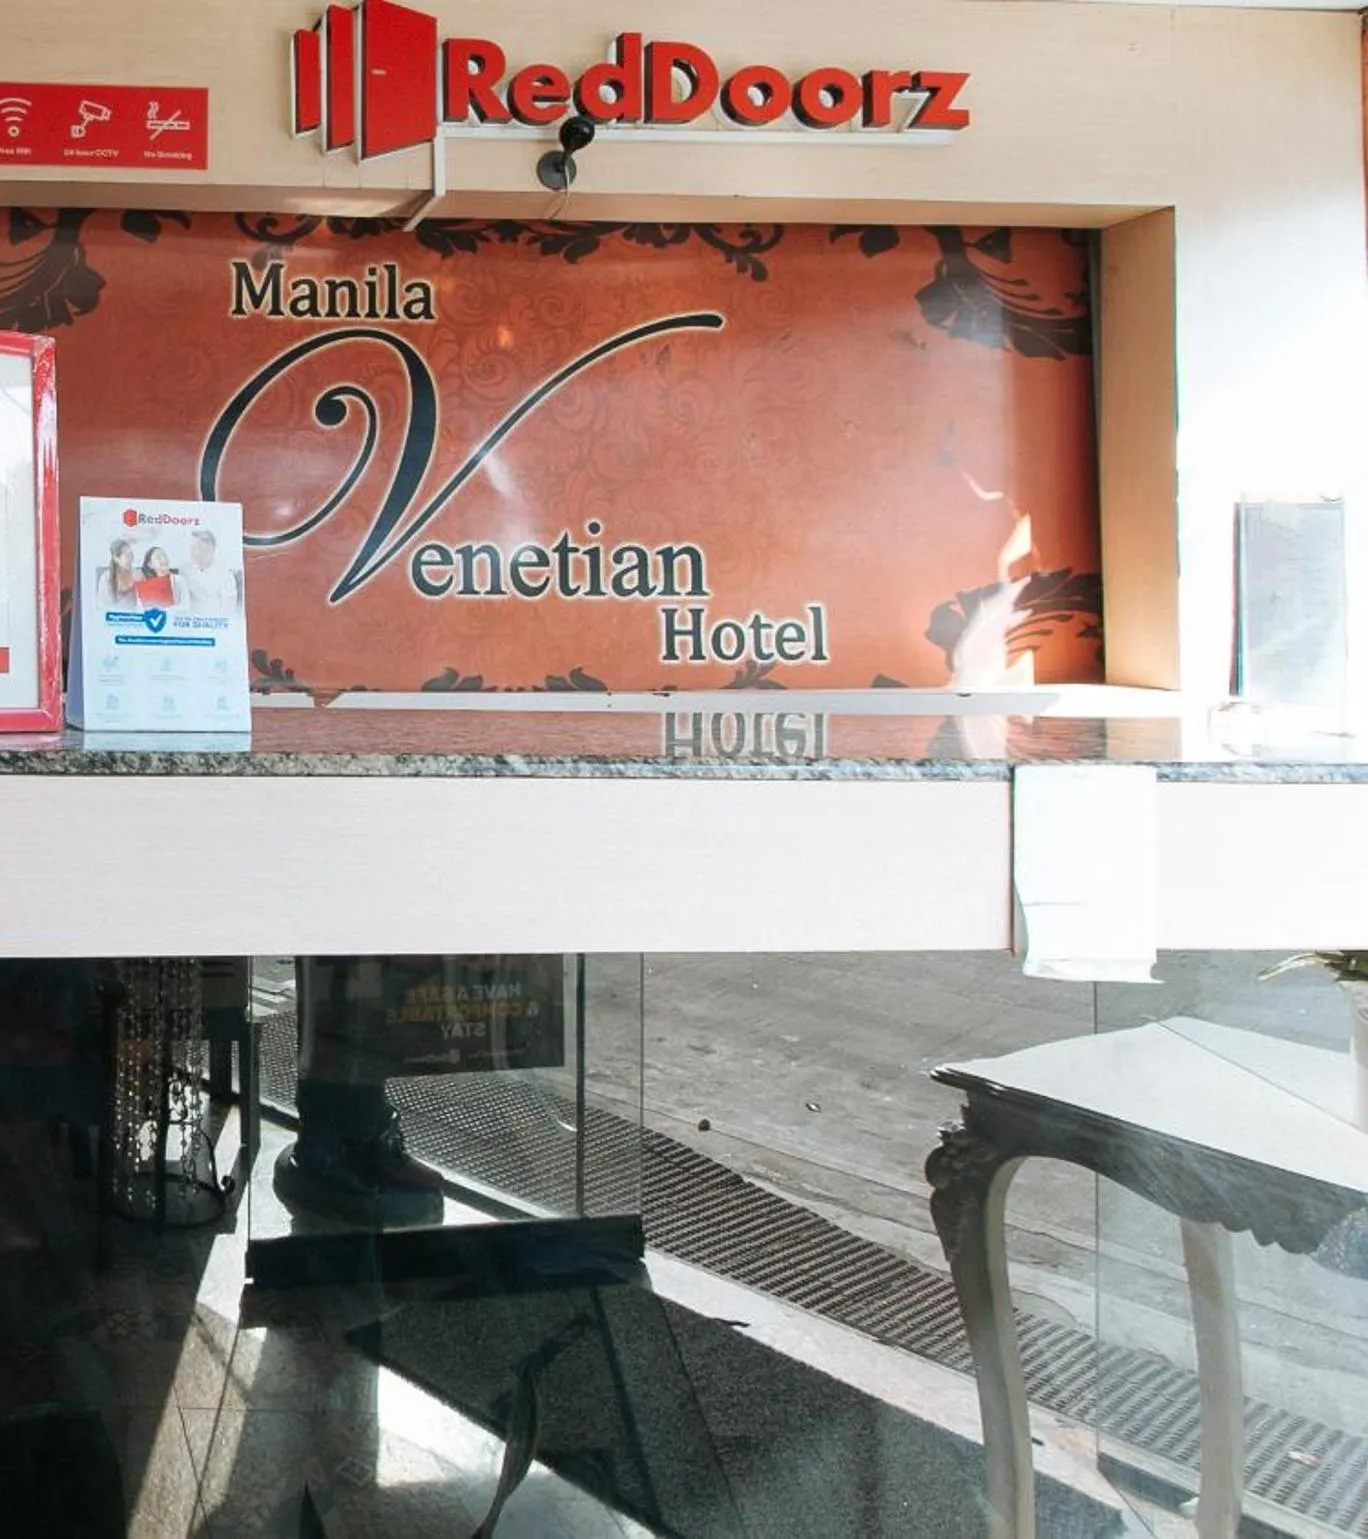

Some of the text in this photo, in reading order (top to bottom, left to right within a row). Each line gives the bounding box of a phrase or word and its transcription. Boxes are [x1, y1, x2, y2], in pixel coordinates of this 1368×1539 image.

[441, 31, 971, 130] RedDoorz
[229, 262, 436, 321] Manila
[660, 605, 830, 663] Hotel
